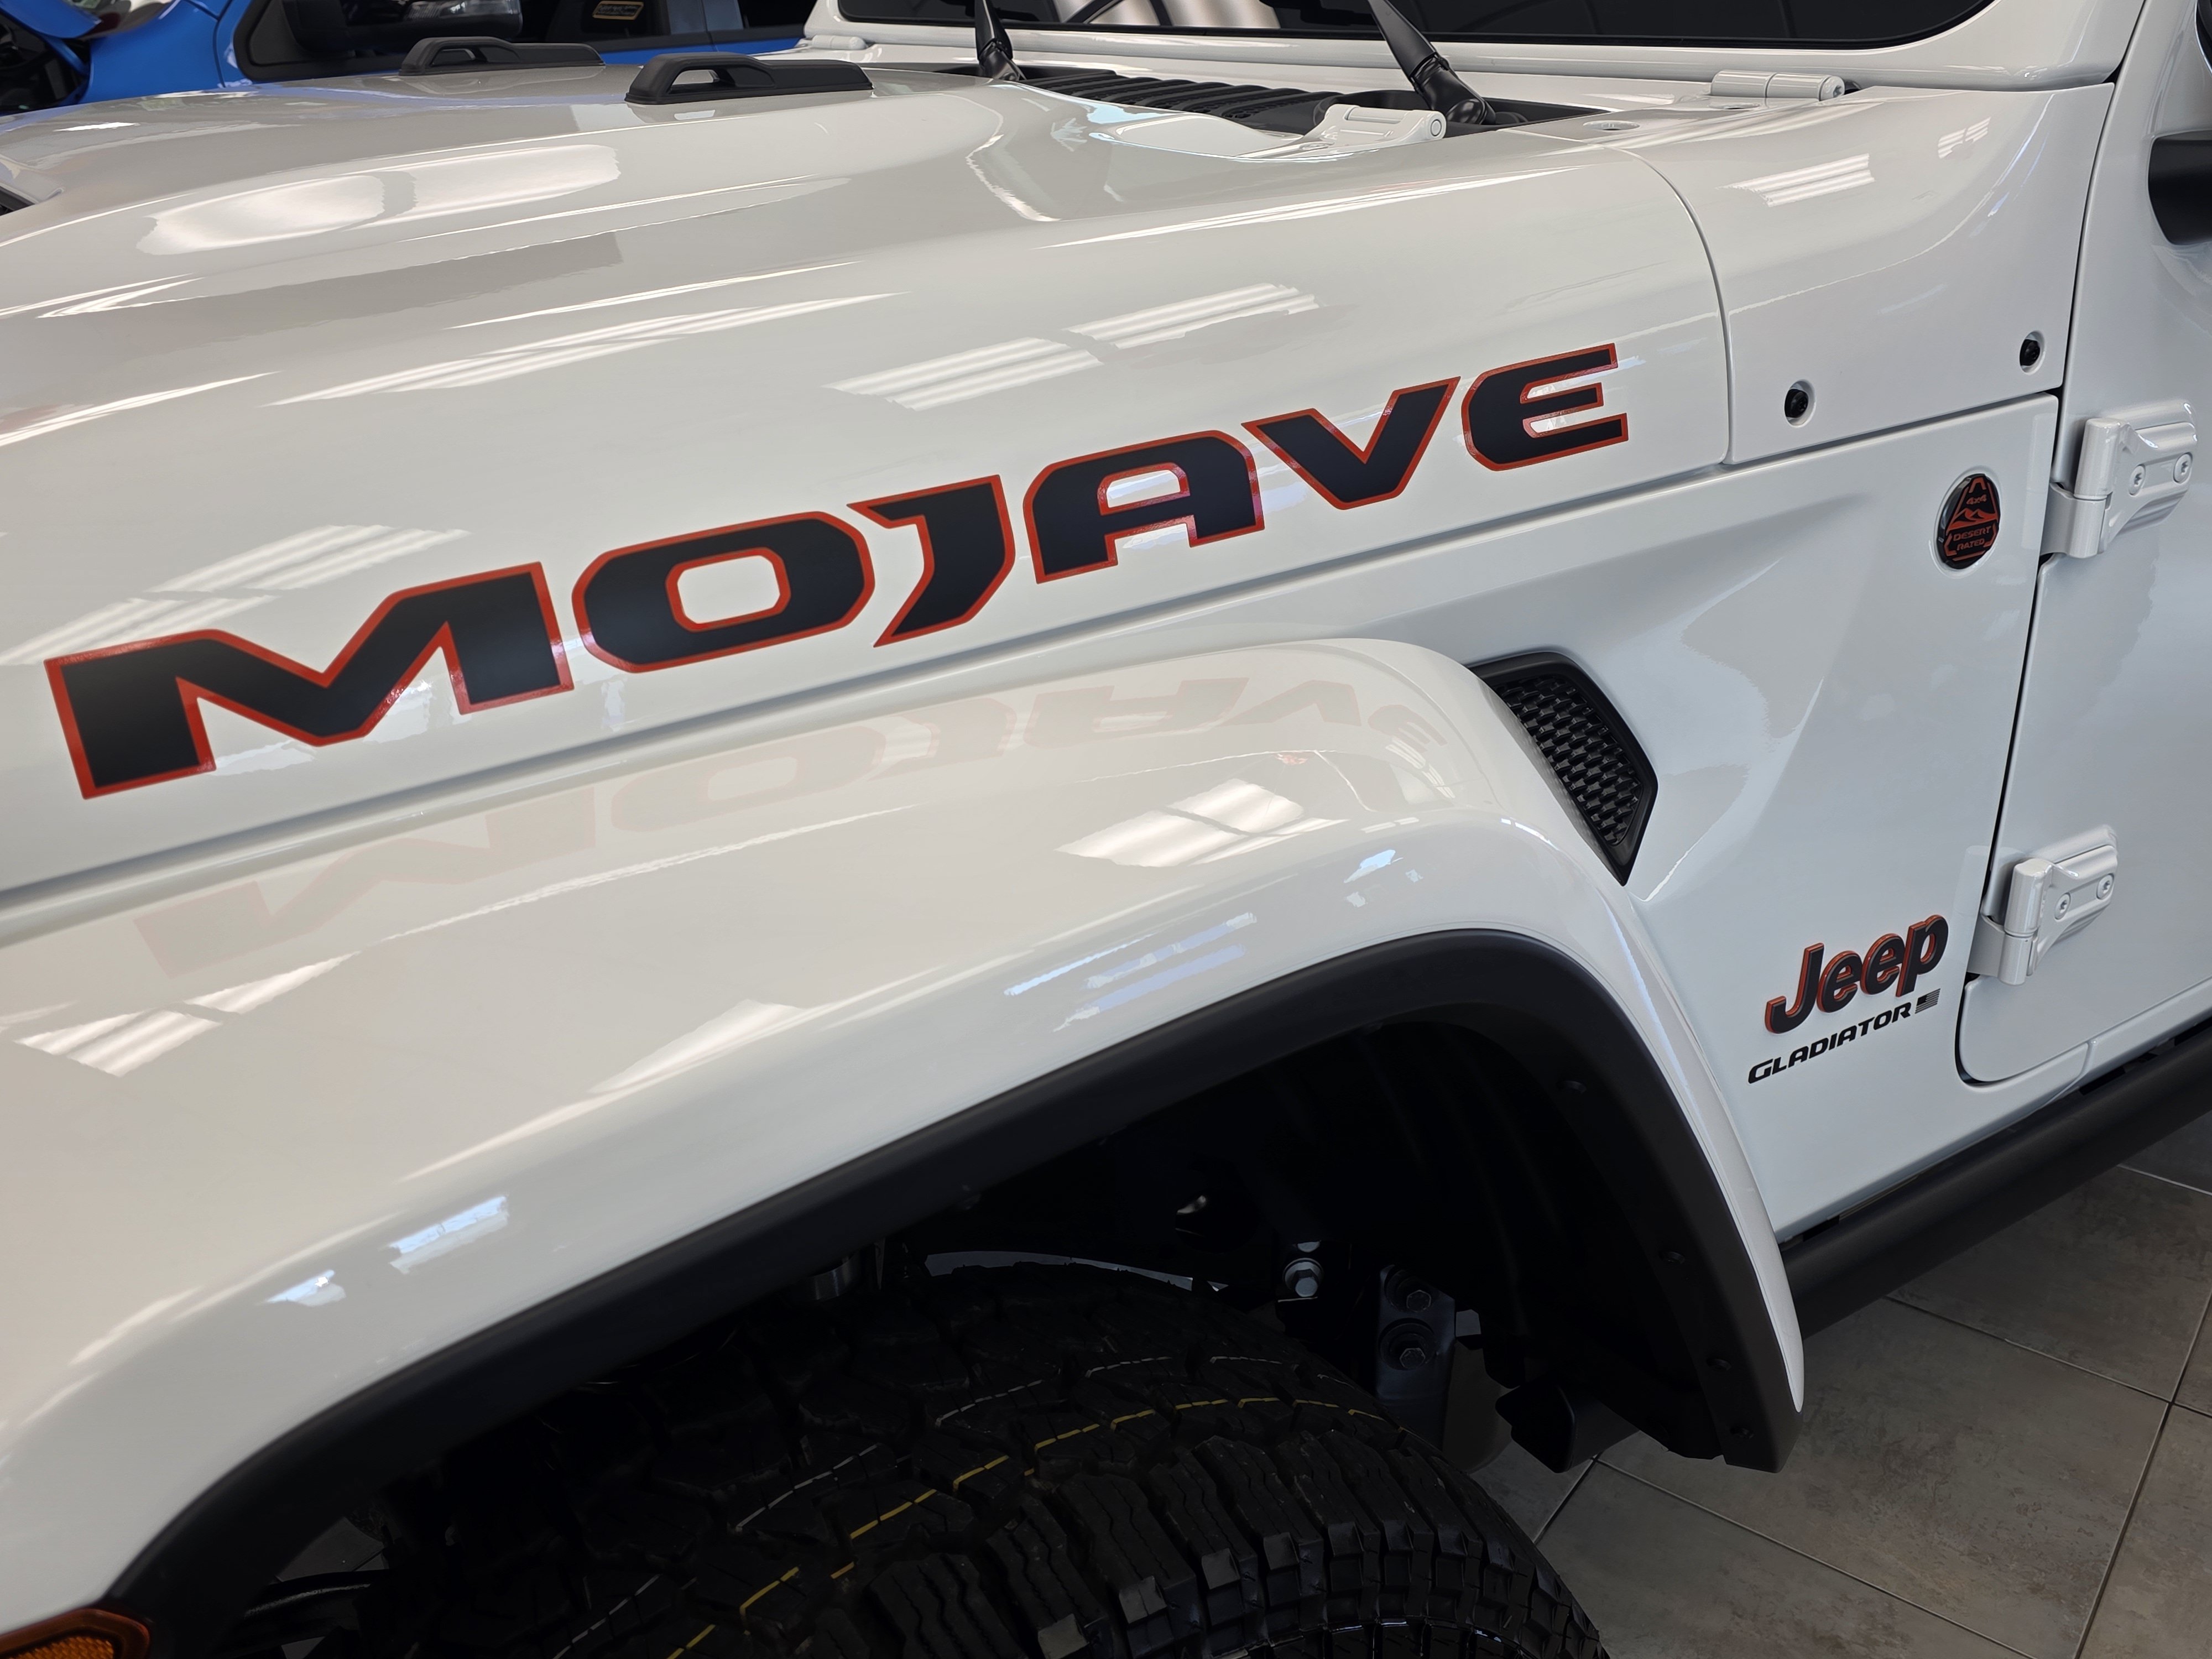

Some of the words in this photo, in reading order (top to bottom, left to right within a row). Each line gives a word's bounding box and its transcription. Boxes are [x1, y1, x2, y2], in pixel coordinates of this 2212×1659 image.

[1966, 494, 1987, 504] 4x4
[1953, 526, 1990, 541] DESERT
[1957, 539, 1985, 551] RATED
[44, 343, 1629, 800] MOJAVE
[1765, 914, 1949, 1034] Jeep
[1748, 1001, 1912, 1084] GLADIATOR
